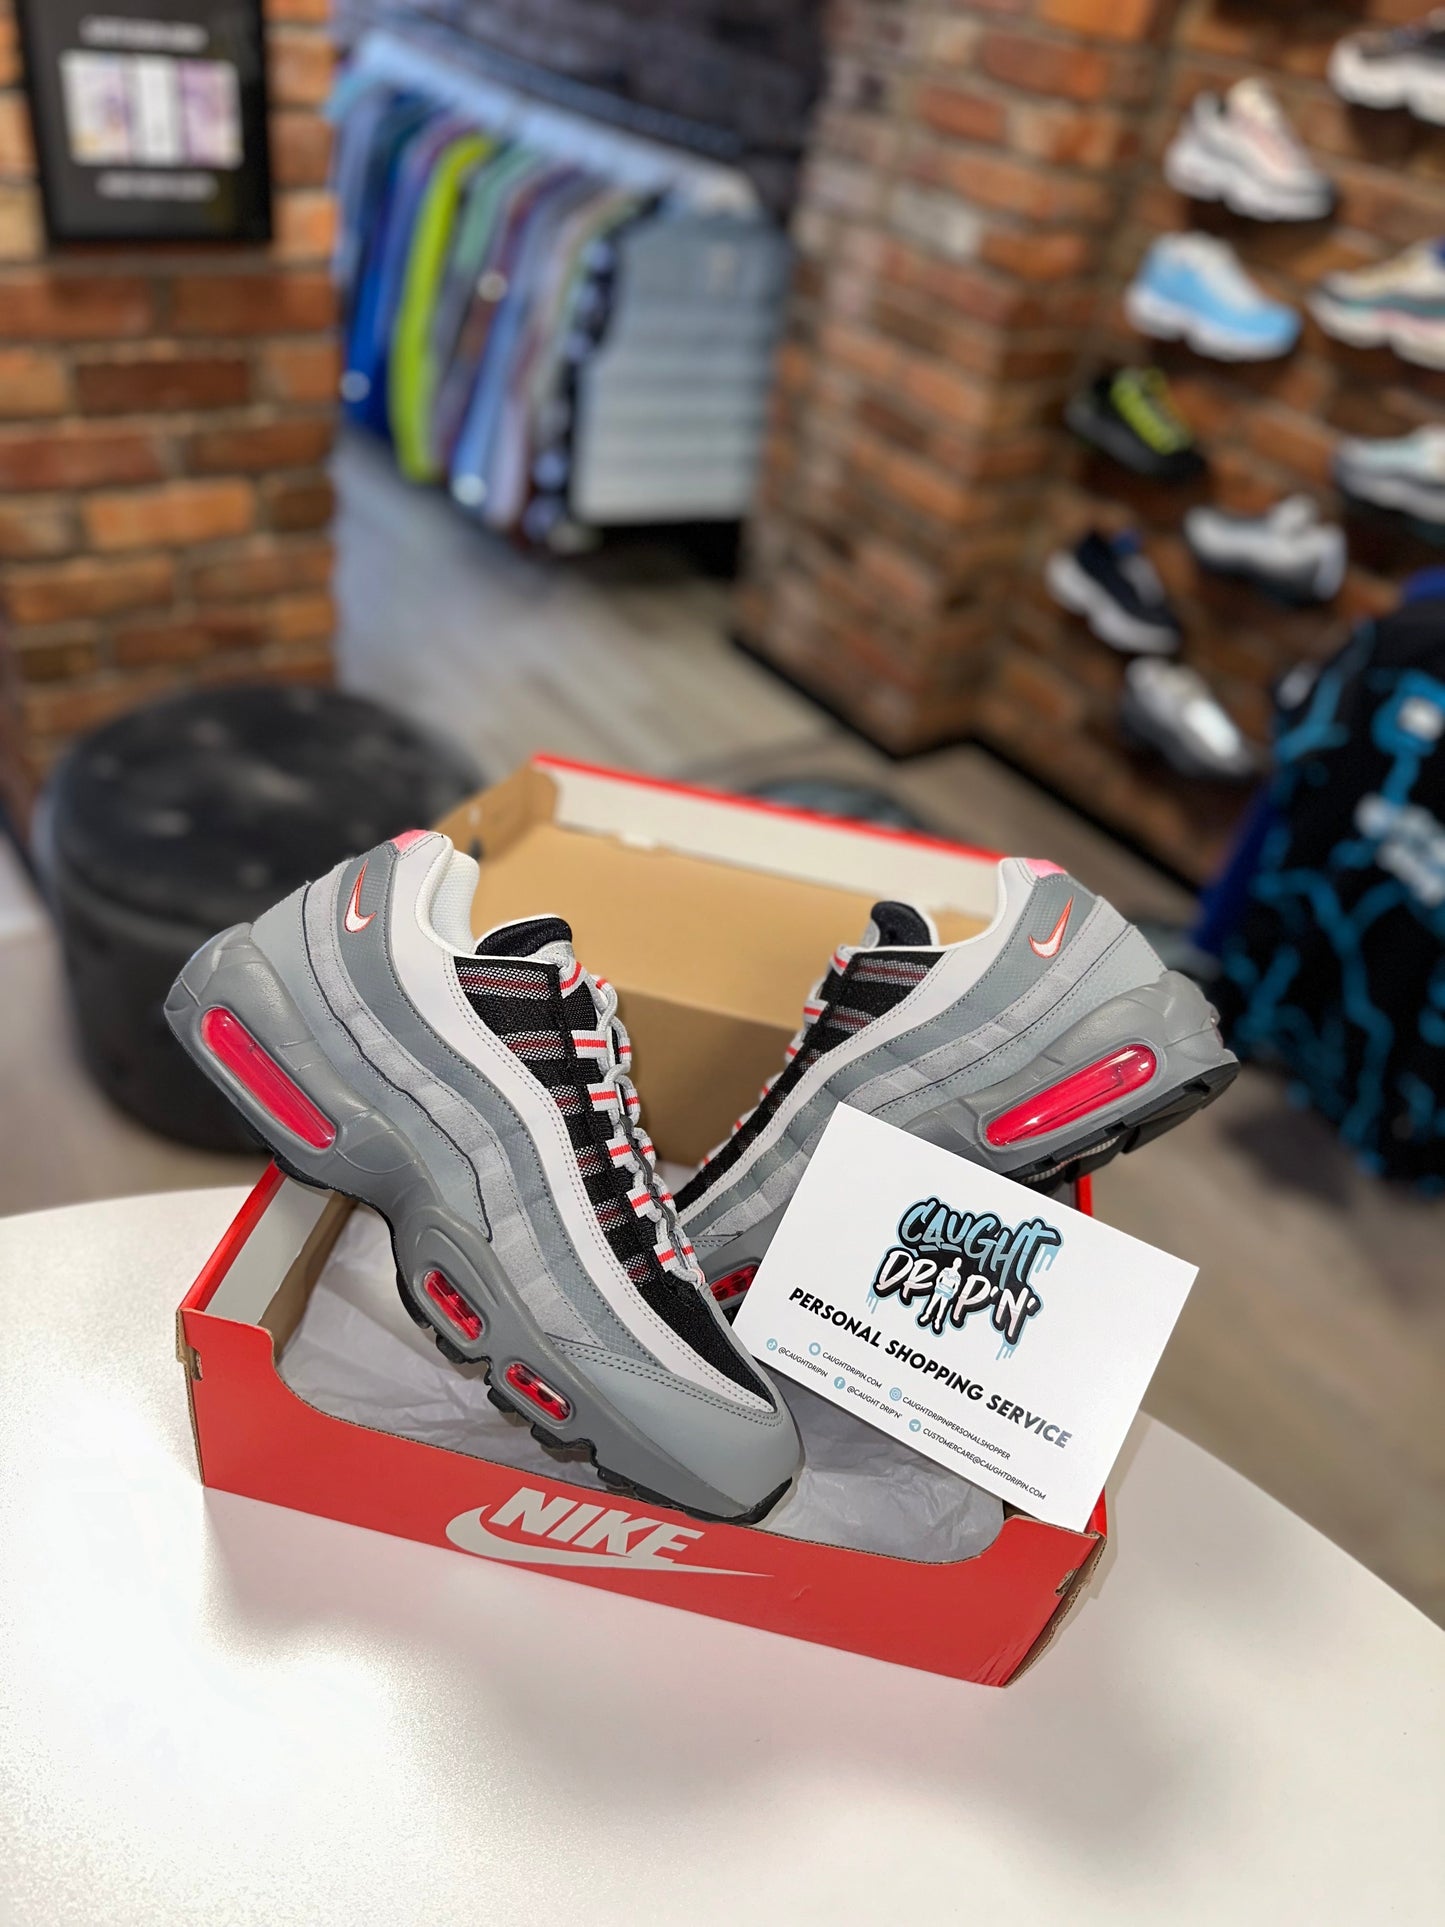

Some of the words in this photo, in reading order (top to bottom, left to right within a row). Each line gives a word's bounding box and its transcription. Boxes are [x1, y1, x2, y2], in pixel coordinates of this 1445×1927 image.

[900, 1199, 1058, 1291] CAUGHT
[778, 1346, 829, 1378] @CAUGHTDRIPIN
[789, 1287, 881, 1348] PERSONAL
[884, 1339, 985, 1401] SHOPPING
[985, 1394, 1073, 1449] SERVICE
[822, 1351, 883, 1389] CAUGHTDRIPIN.COM
[846, 1385, 881, 1408] @CAUGHT
[902, 1396, 1011, 1460] CAUGHTDRIPINPERSONALSHOPPER
[922, 1427, 1047, 1500] CUSTOMERCARE@CAUGHTDRIPIN.COM
[488, 1486, 705, 1564] NIKE
